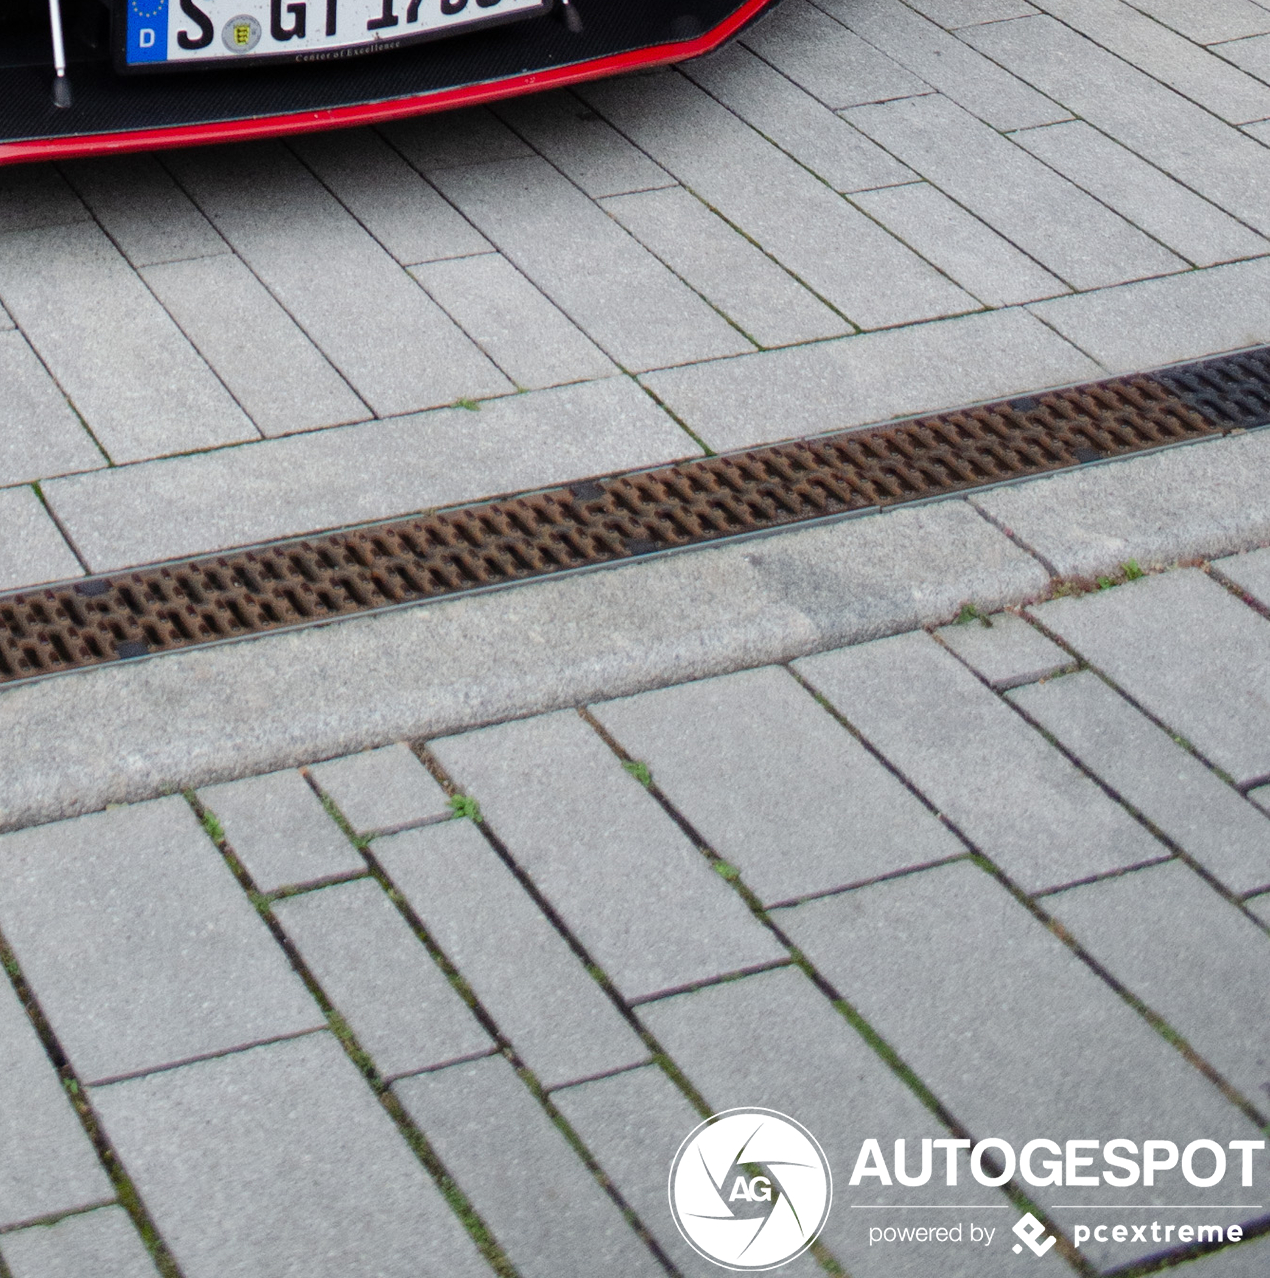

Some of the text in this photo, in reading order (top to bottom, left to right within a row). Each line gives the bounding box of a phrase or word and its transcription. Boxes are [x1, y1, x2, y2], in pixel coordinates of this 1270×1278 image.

[139, 28, 156, 49] D
[295, 41, 402, 62] Center of Excellence
